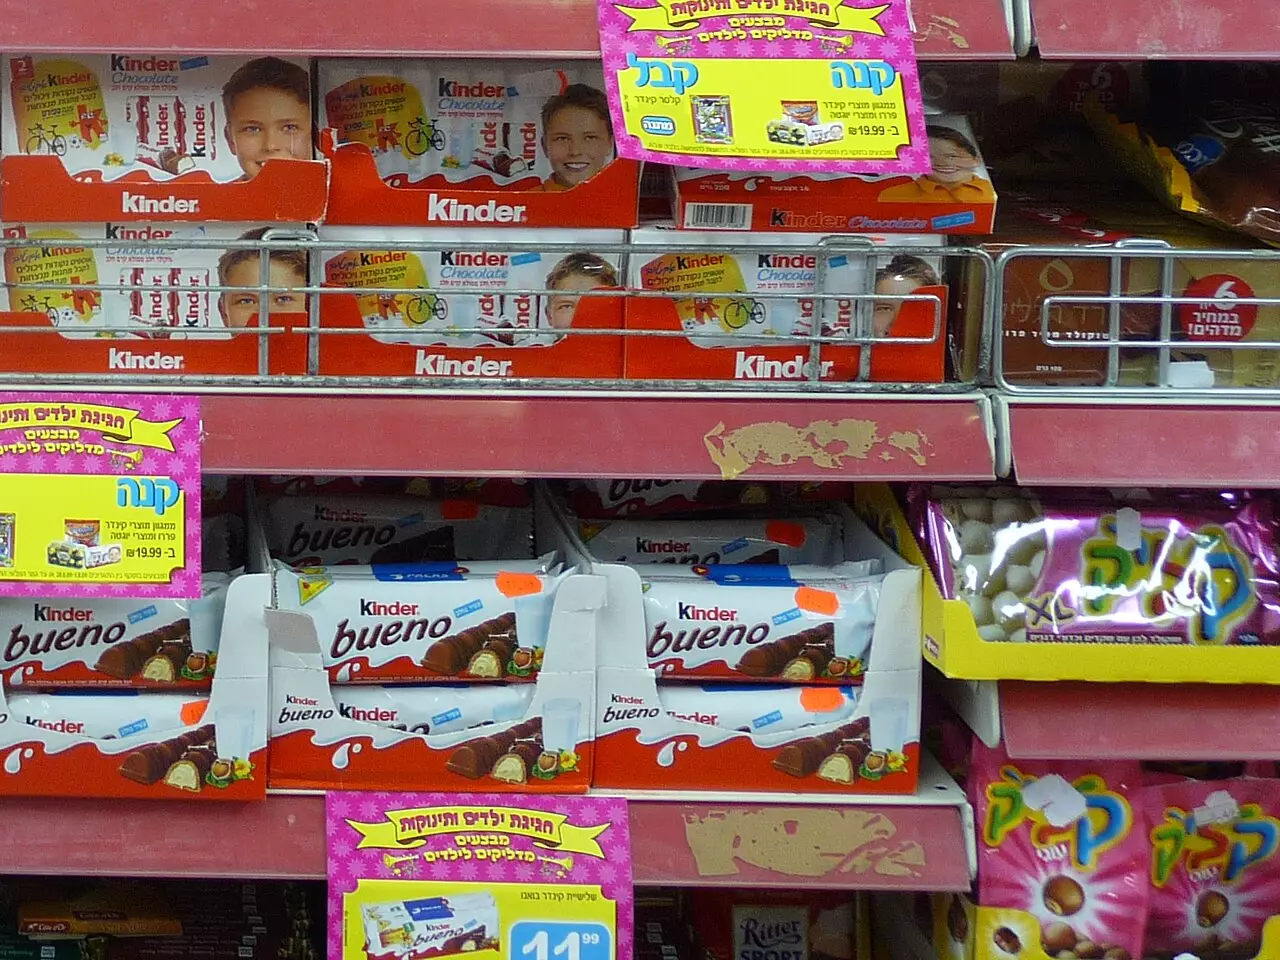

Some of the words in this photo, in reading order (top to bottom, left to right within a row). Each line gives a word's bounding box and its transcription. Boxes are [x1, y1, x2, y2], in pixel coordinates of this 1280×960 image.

[111, 54, 178, 71] Kinder
[112, 72, 179, 84] Chocolate
[626, 52, 698, 95] קבל
[829, 59, 896, 95] קנה
[439, 78, 505, 98] Kinder
[438, 98, 505, 111] Chocolate
[122, 191, 199, 214] Kinder
[428, 194, 527, 222] Kinder
[771, 208, 846, 228] Kinder
[105, 223, 173, 240] Kinder
[360, 251, 407, 266] Kinder
[440, 251, 508, 266] Kinder
[676, 254, 724, 269] Kinder
[440, 267, 509, 280] Chocolate
[1192, 312, 1240, 324] במחיר
[109, 347, 184, 369] Kinder
[416, 349, 512, 376] Kinder
[117, 477, 180, 515] קנה
[34, 603, 94, 622] Kinder
[360, 598, 419, 617] Kinder
[678, 601, 738, 622] Kinder
[4, 621, 127, 663] bueno
[330, 614, 452, 660] bueno
[647, 621, 770, 658] bueno
[286, 694, 318, 706] Kinder
[278, 707, 333, 724] bueno
